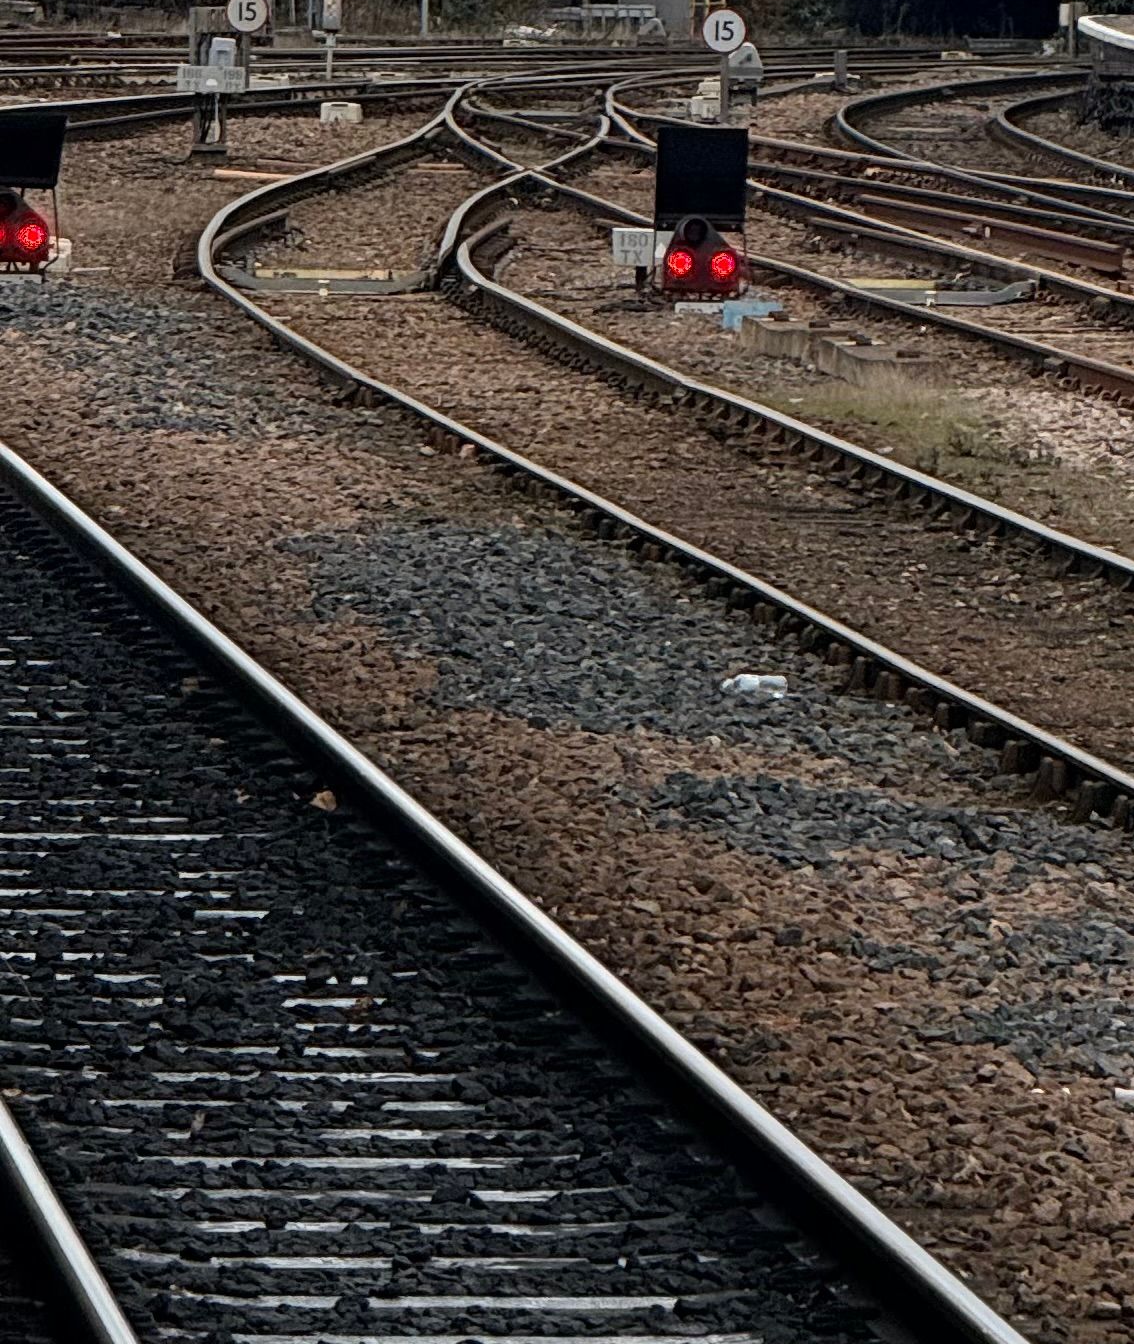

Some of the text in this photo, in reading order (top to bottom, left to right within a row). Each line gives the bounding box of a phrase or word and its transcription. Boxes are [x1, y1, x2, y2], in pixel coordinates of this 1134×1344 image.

[238, 1, 257, 22] 15
[715, 20, 734, 41] 15
[620, 250, 643, 264] TX
